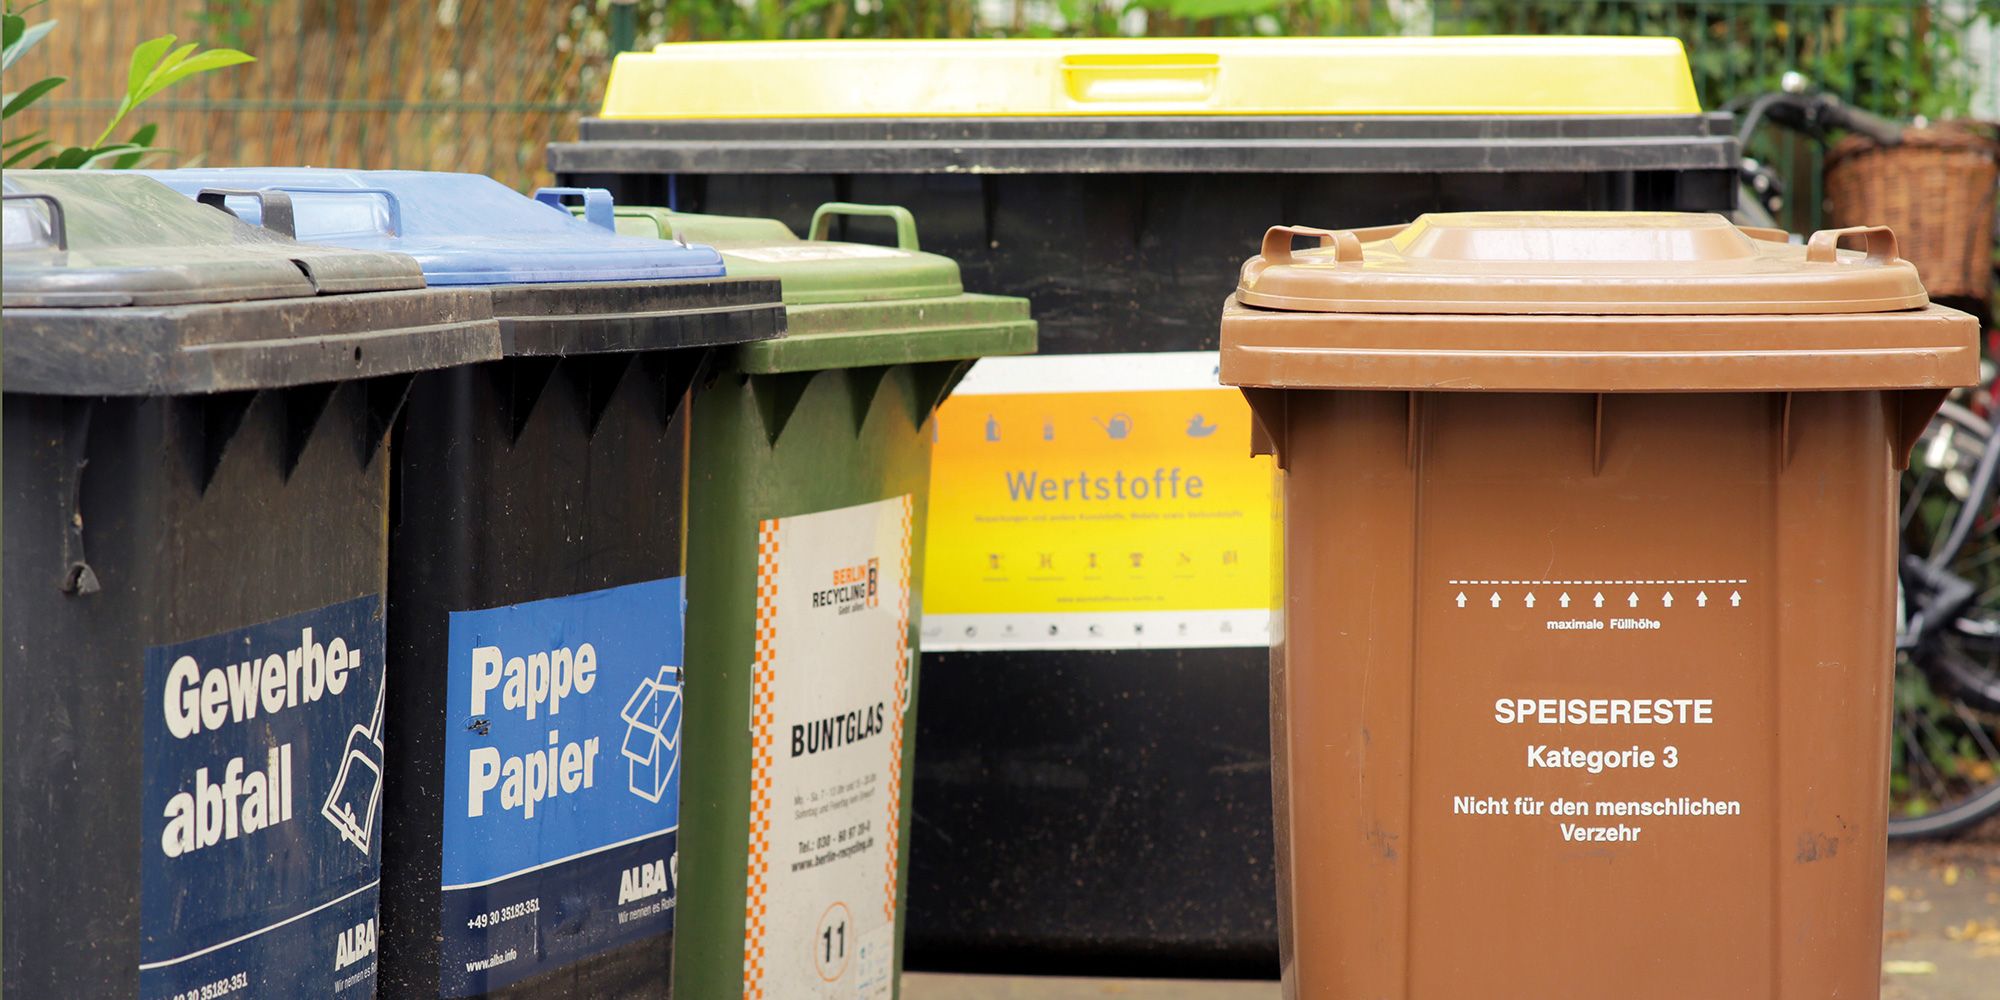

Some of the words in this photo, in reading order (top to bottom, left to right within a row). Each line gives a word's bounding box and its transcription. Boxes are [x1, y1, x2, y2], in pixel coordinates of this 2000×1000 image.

[1005, 467, 1204, 502] Wertstoffe
[833, 565, 866, 586] BERLIN
[812, 583, 865, 608] RECYCLING
[1546, 618, 1604, 630] maximale
[1610, 618, 1661, 630] Füllhöhe
[163, 627, 360, 740] Gewerbe-
[471, 642, 597, 720] Pappe
[1494, 698, 1713, 724] SPEISERESTE
[791, 702, 884, 758] BUNTGLAS
[468, 730, 599, 819] Papier
[1527, 745, 1655, 774] Kategorie
[1662, 745, 1679, 768] 3
[161, 743, 292, 858] abfall
[1453, 796, 1509, 815] Nicht
[1514, 797, 1544, 815] für
[1550, 797, 1589, 815] den
[1595, 797, 1741, 815] menschlichen
[1560, 824, 1641, 841] Verzehr
[618, 859, 668, 906] ALBA
[467, 913, 488, 929] +49
[489, 910, 500, 925] 30
[501, 897, 540, 922] 35182-351
[335, 918, 376, 972] ALBA
[823, 920, 845, 963] 11
[465, 948, 517, 972] www.alba.info
[201, 971, 248, 1000] 35182-351
